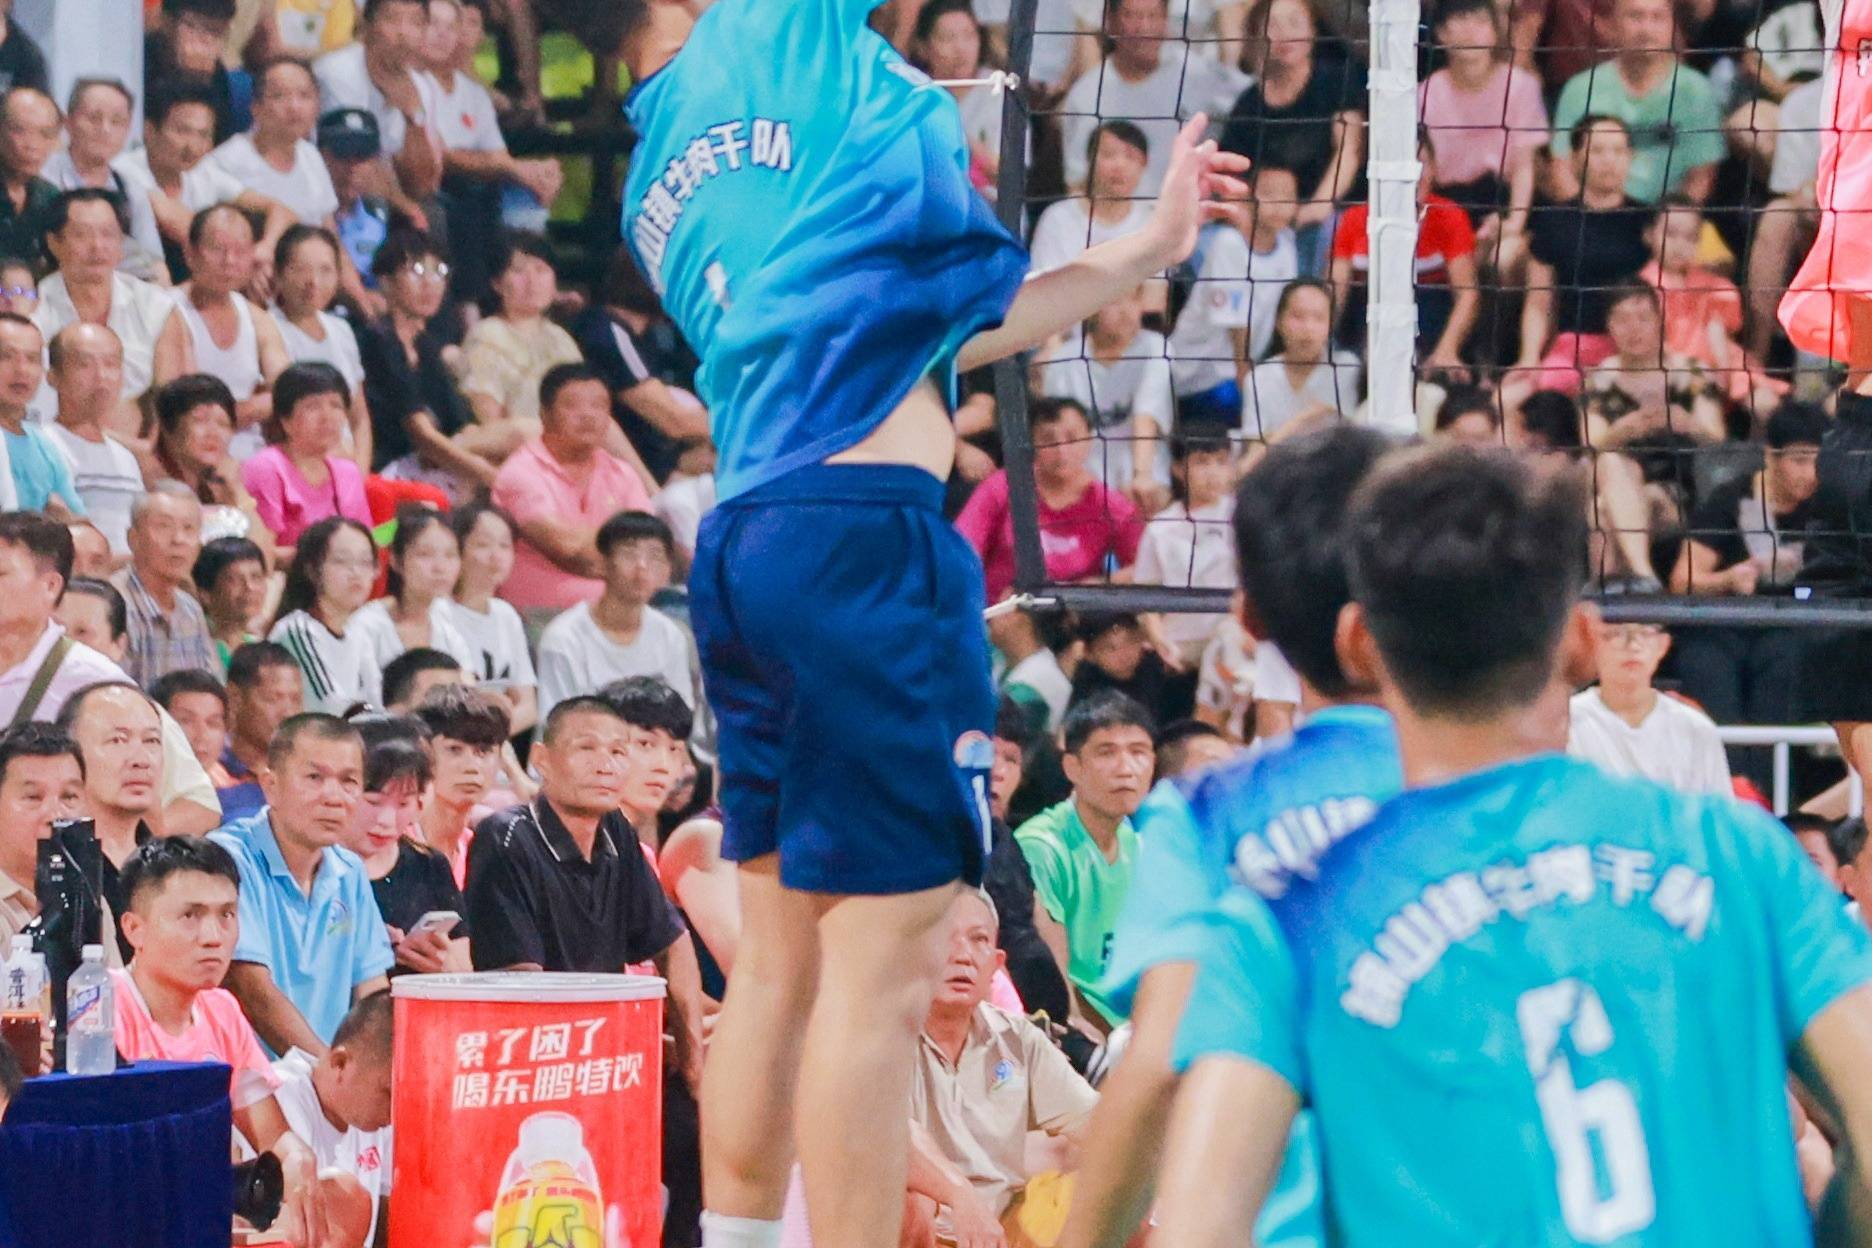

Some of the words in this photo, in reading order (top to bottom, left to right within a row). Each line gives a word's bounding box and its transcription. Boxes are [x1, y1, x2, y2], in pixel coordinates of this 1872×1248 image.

[455, 1017, 608, 1069] 累了困了
[452, 1052, 645, 1111] 喝东鹏特饮
[1516, 977, 1656, 1245] 6
